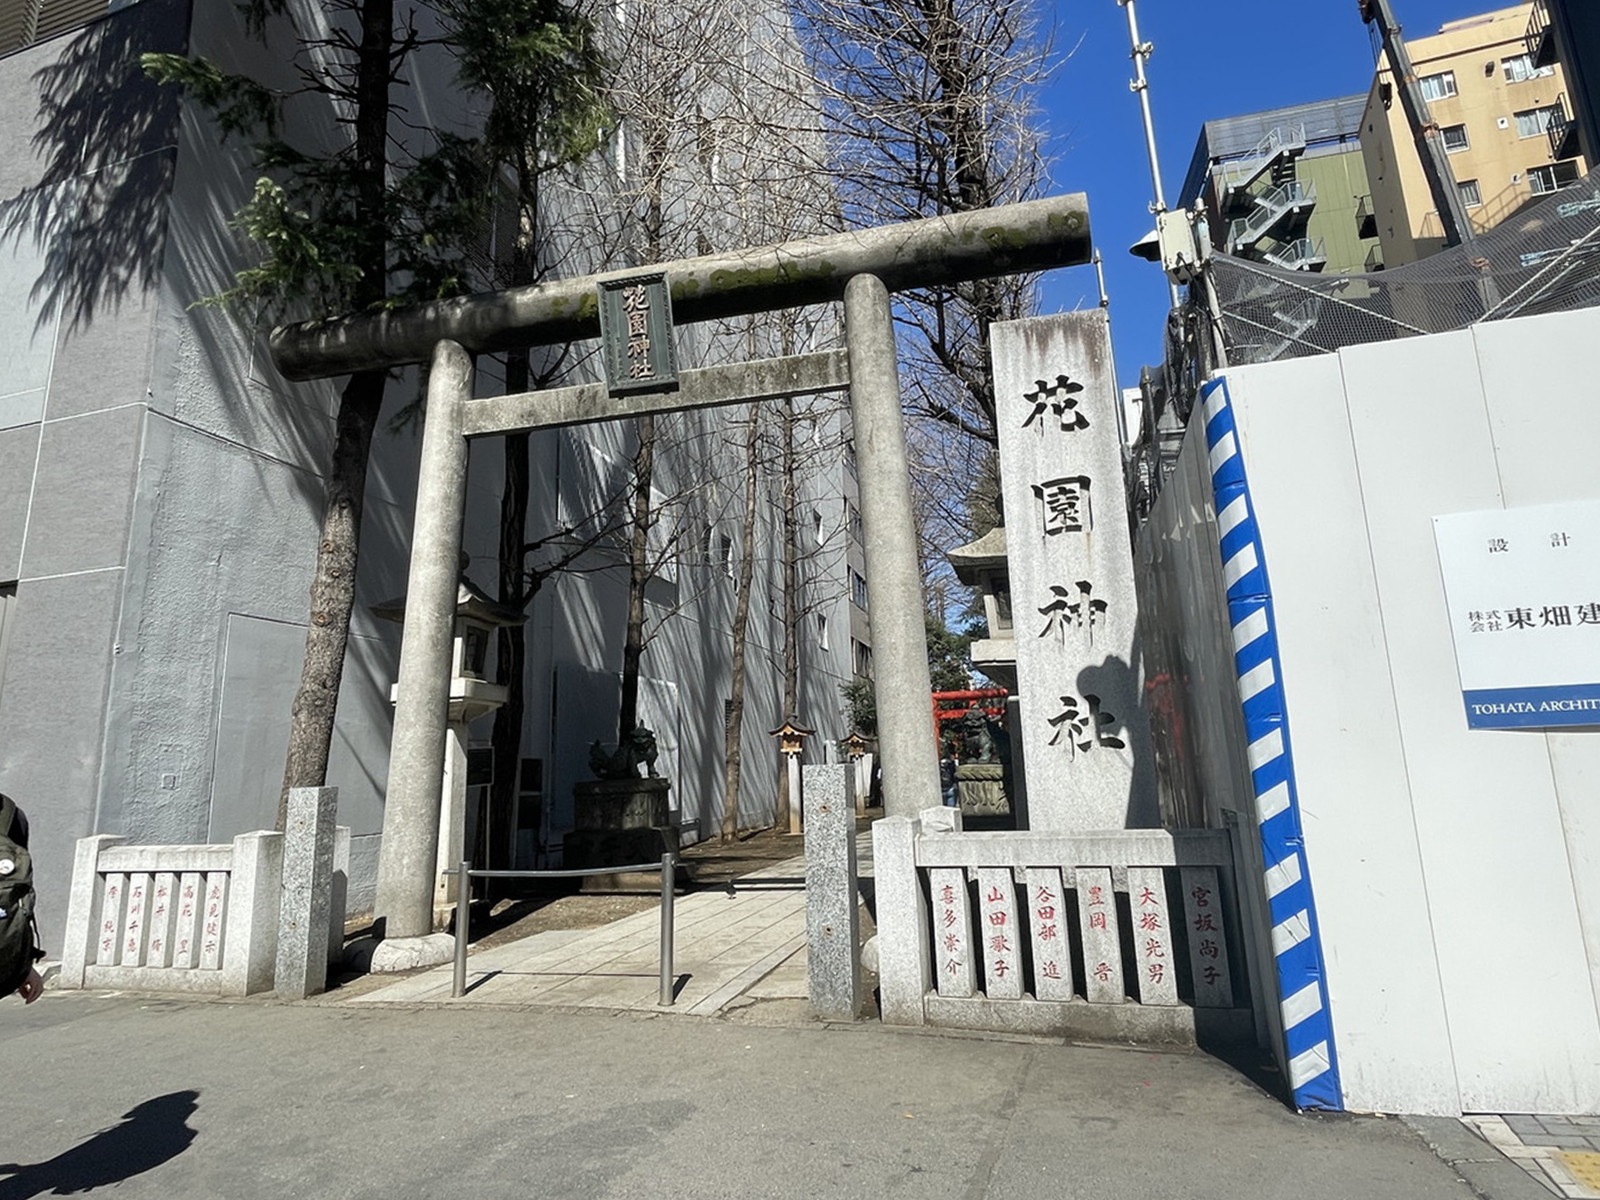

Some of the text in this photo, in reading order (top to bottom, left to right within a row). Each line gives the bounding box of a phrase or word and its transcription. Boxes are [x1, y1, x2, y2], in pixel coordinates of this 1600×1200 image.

[622, 284, 655, 380] 花園神社
[1021, 374, 1125, 762] 花園神社
[1487, 532, 1571, 553] 設計
[1472, 698, 1600, 715] TOHATA ARCHIT
[939, 884, 962, 976] 喜多崇介
[987, 886, 1011, 978] 山田歌子
[1036, 886, 1061, 980] 谷田部進
[1139, 886, 1165, 984] 大塚光男
[1192, 886, 1221, 985] 宮坂尚子
